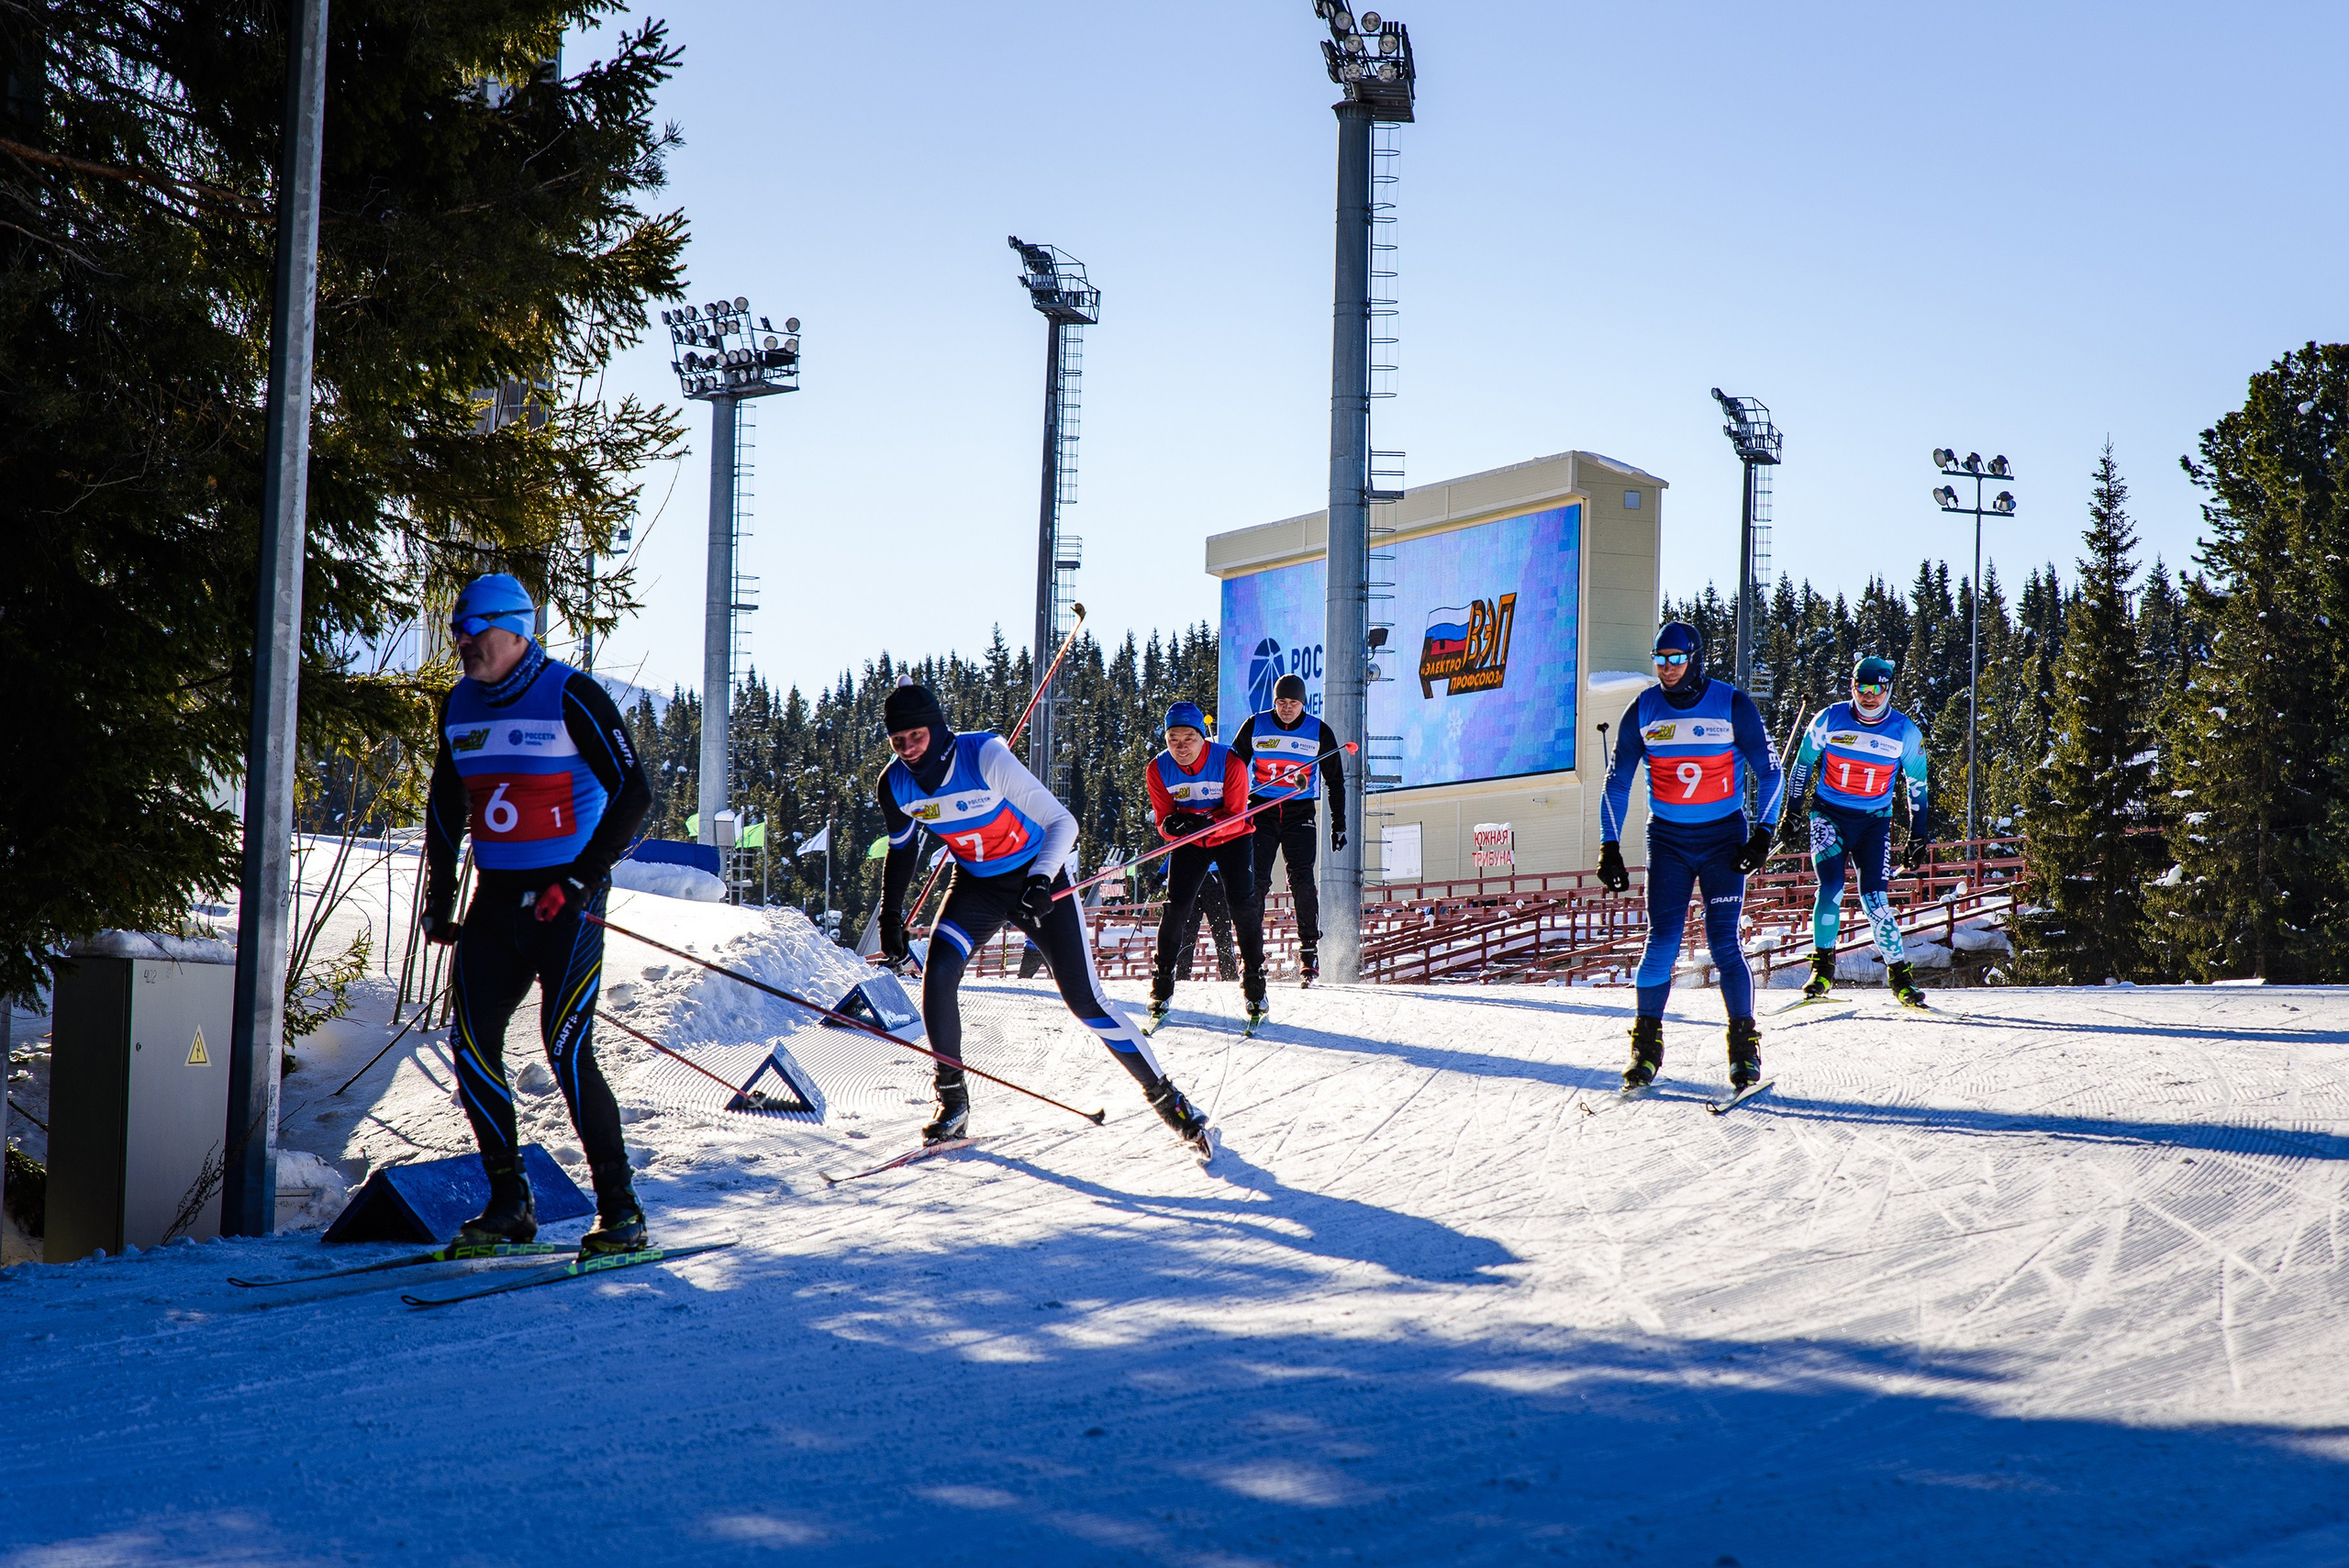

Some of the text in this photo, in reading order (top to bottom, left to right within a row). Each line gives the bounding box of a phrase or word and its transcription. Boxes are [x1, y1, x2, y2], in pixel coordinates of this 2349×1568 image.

[1463, 592, 1517, 669] ВЭП
[612, 728, 633, 761] CRAFT
[1676, 762, 1728, 798] 9 1
[1839, 762, 1876, 793] 11
[484, 783, 562, 833] 6 1
[954, 832, 985, 862] 7
[1475, 829, 1508, 847] ЮЖНАЯ
[1472, 851, 1512, 867] ТРИБУНА
[1710, 895, 1739, 905] CRAFT
[553, 1021, 573, 1056] CRAFT
[455, 1243, 555, 1260] FISCHER
[584, 1249, 663, 1273] FISCHER
